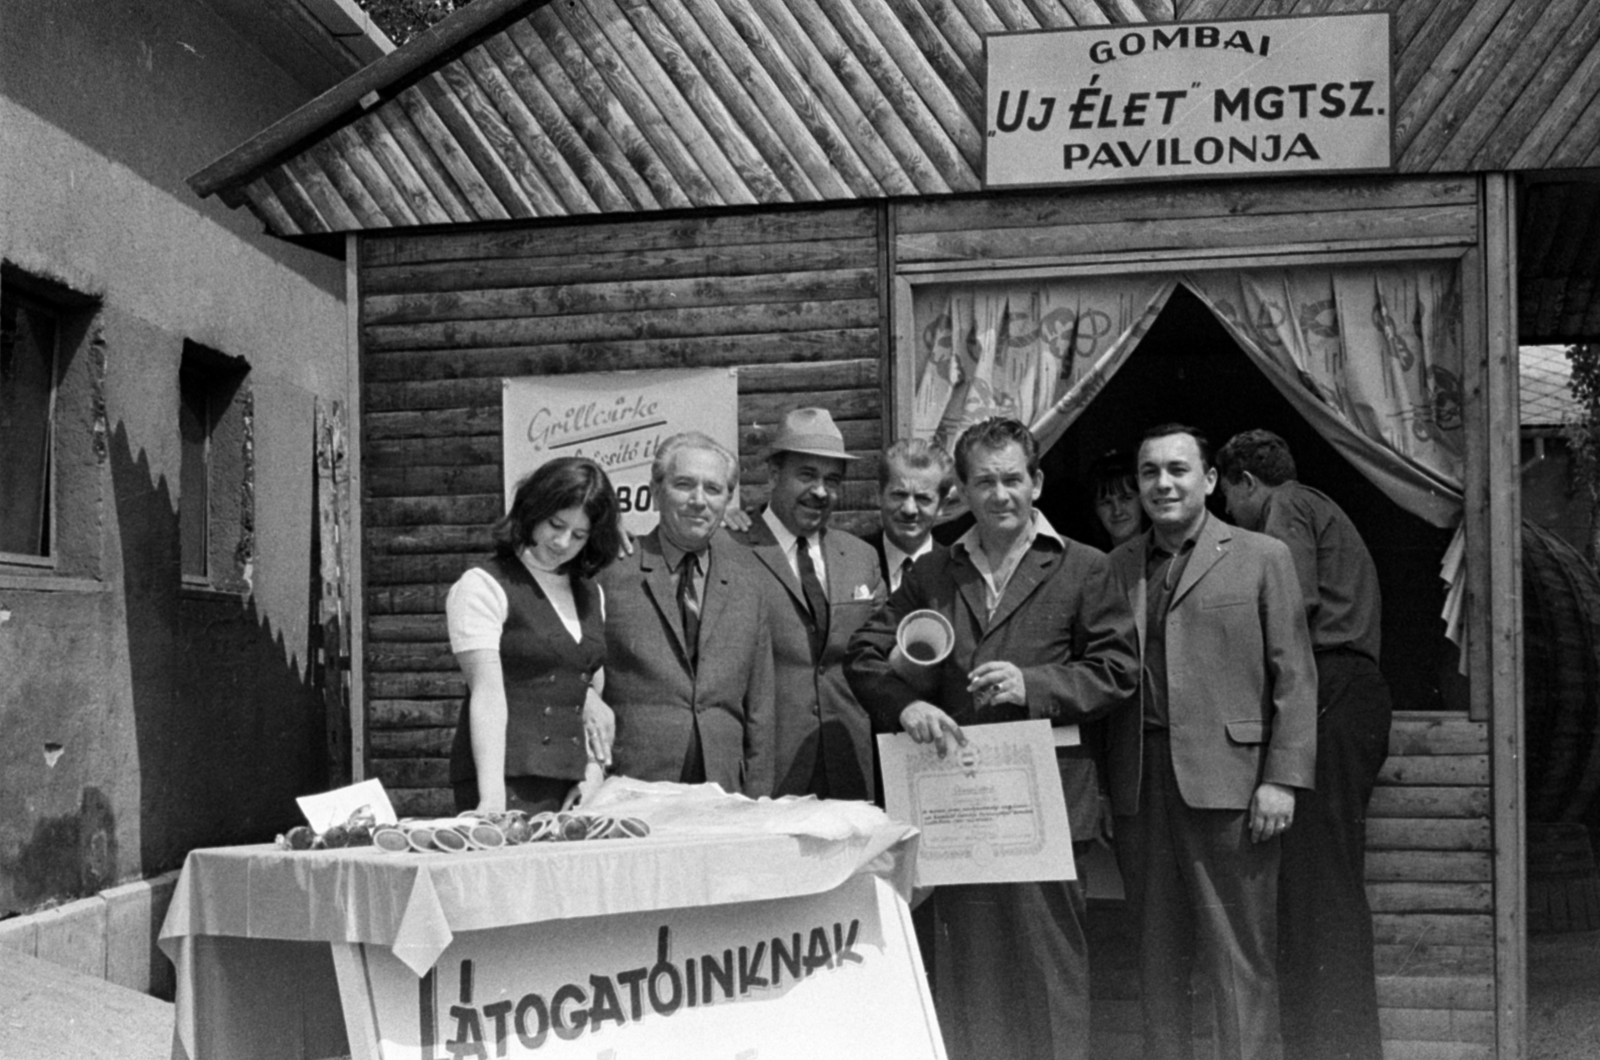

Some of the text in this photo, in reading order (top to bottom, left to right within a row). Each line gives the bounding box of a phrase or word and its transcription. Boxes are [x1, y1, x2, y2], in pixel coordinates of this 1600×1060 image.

[1089, 26, 1270, 64] GOMBAI
[1213, 81, 1385, 123] MGTSZ.
[1063, 133, 1321, 170] PAVILONJA
[616, 485, 652, 513] BO
[418, 919, 864, 1060] LÁTOGATÓINKNAK
